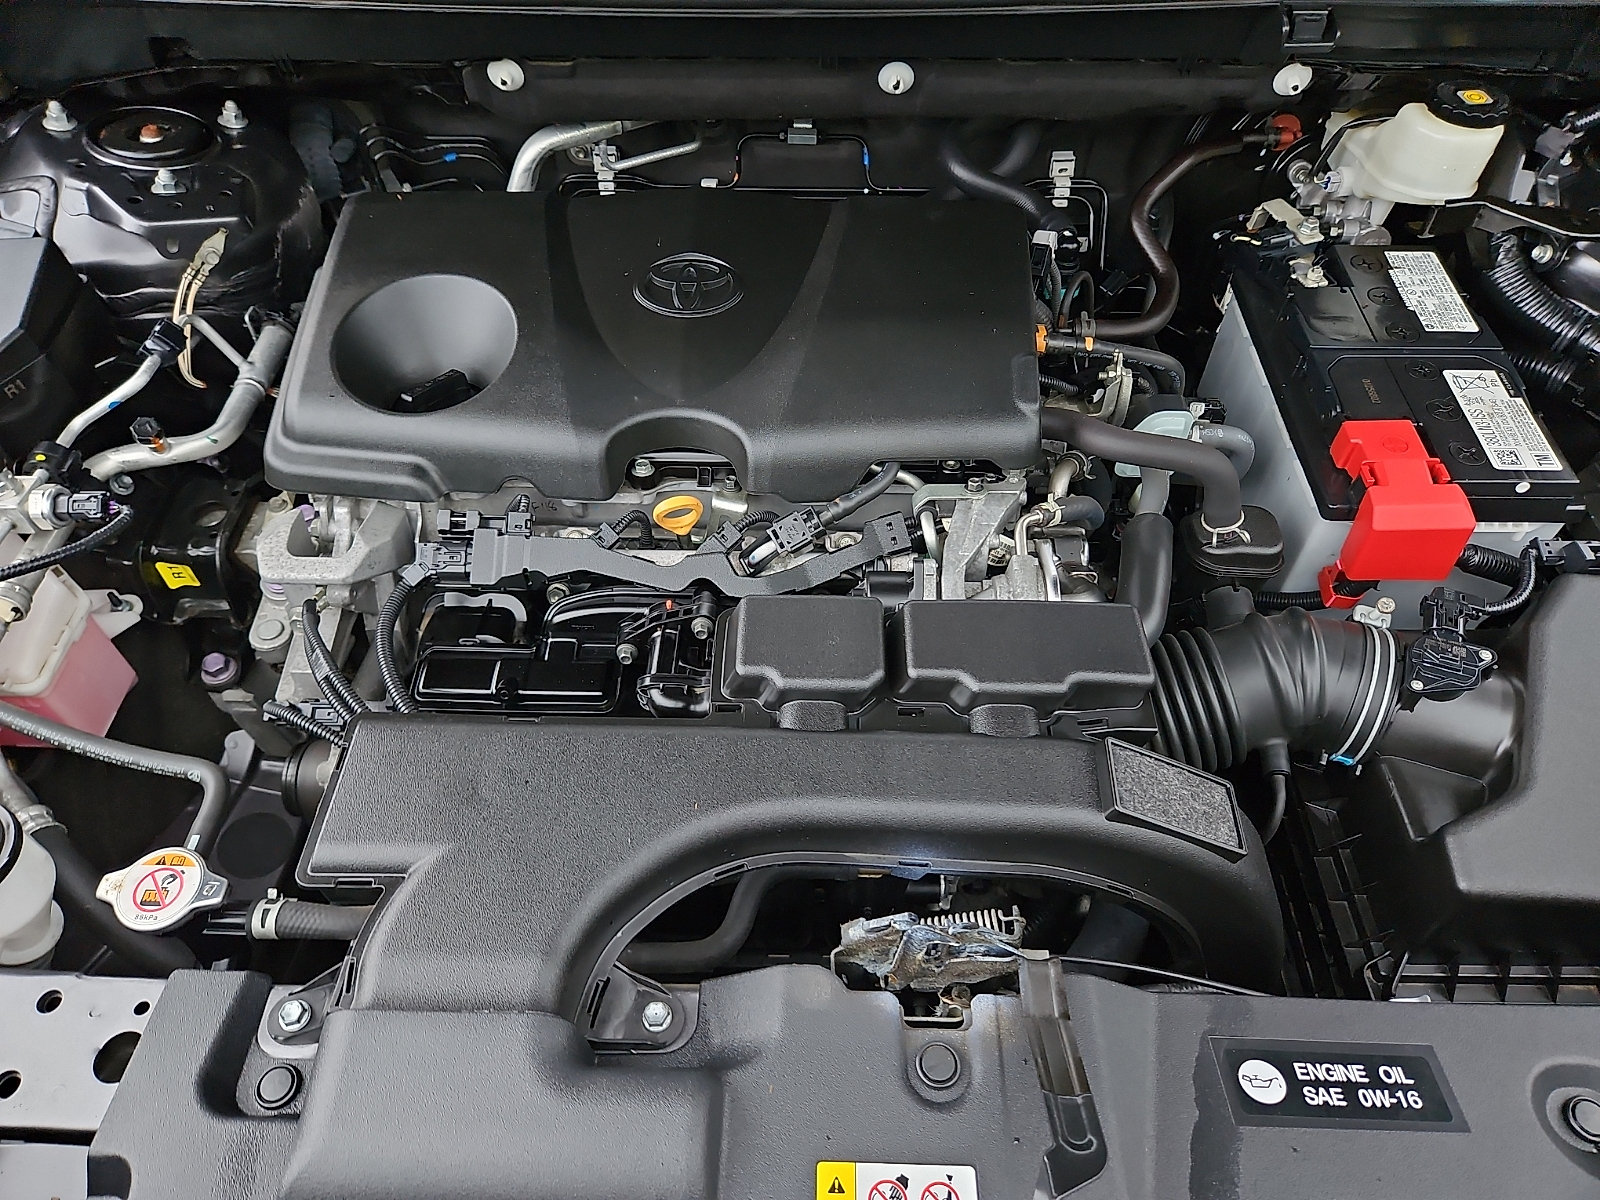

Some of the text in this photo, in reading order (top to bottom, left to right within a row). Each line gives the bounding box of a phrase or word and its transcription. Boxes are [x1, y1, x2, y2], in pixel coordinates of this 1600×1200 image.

[4, 379, 26, 399] R1
[1489, 378, 1500, 388] Pb
[1533, 454, 1557, 467] TM
[167, 566, 187, 578] R1
[1292, 1062, 1415, 1085] ENGINE OIL
[1302, 1086, 1423, 1110] SAE 0W-16
